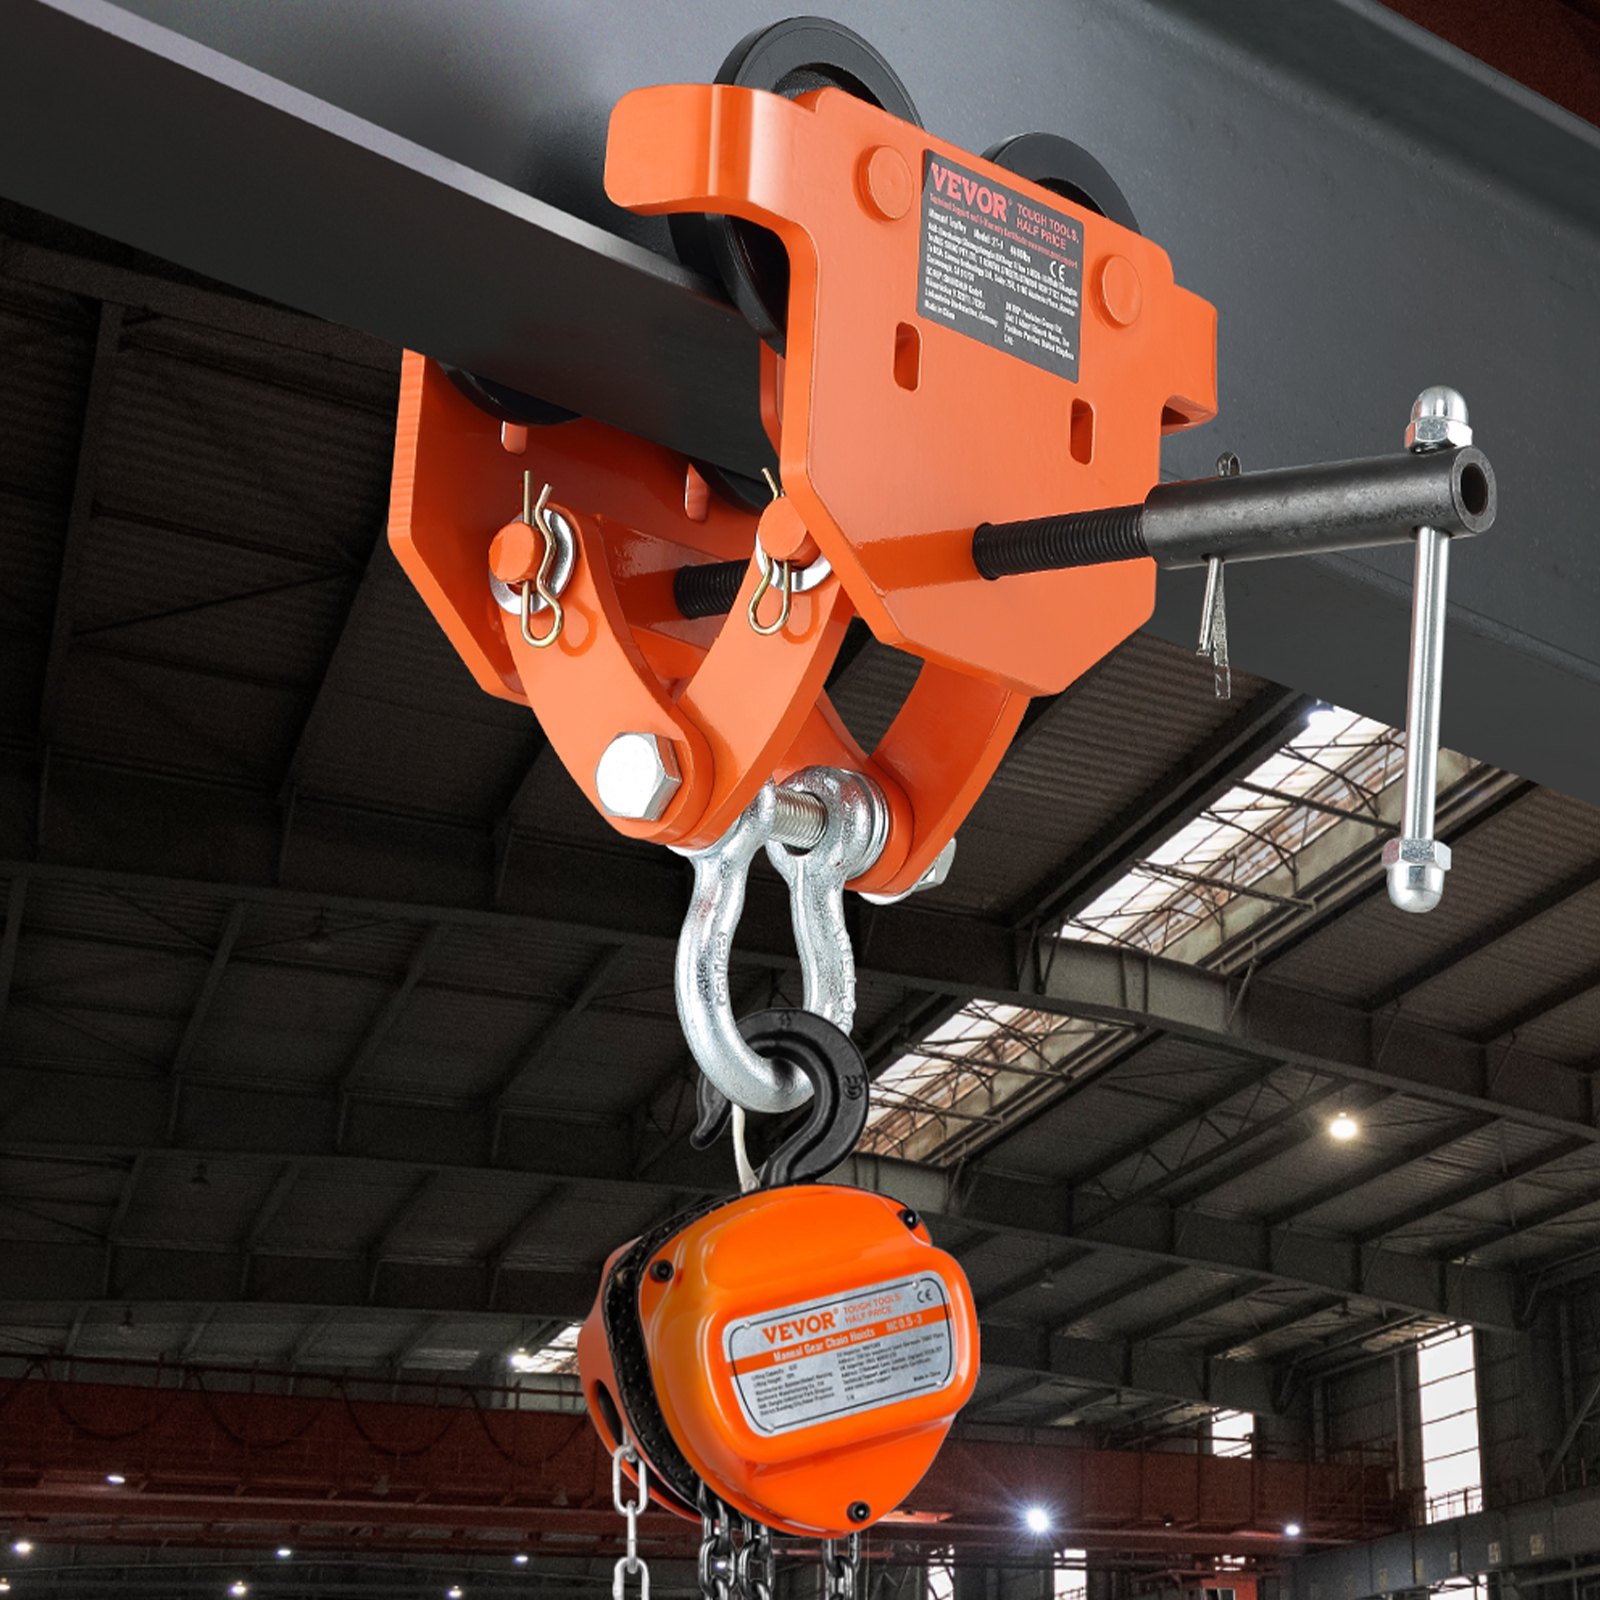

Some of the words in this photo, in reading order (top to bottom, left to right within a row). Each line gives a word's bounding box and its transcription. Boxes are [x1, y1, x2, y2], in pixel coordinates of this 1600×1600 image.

[930, 162, 1007, 222] VEVOR
[1018, 204, 1047, 226] TOUGH
[1017, 218, 1038, 236] HALF
[1041, 230, 1066, 249] PRICE
[844, 1301, 872, 1314] TOUGH
[846, 1312, 866, 1323] HALF
[868, 1306, 893, 1317] PRICE
[761, 1312, 836, 1344] VEVOR
[773, 1346, 803, 1362] Manual
[804, 1340, 825, 1353] Gear
[825, 1333, 849, 1348] Chain
[849, 1326, 875, 1341] Hoists
